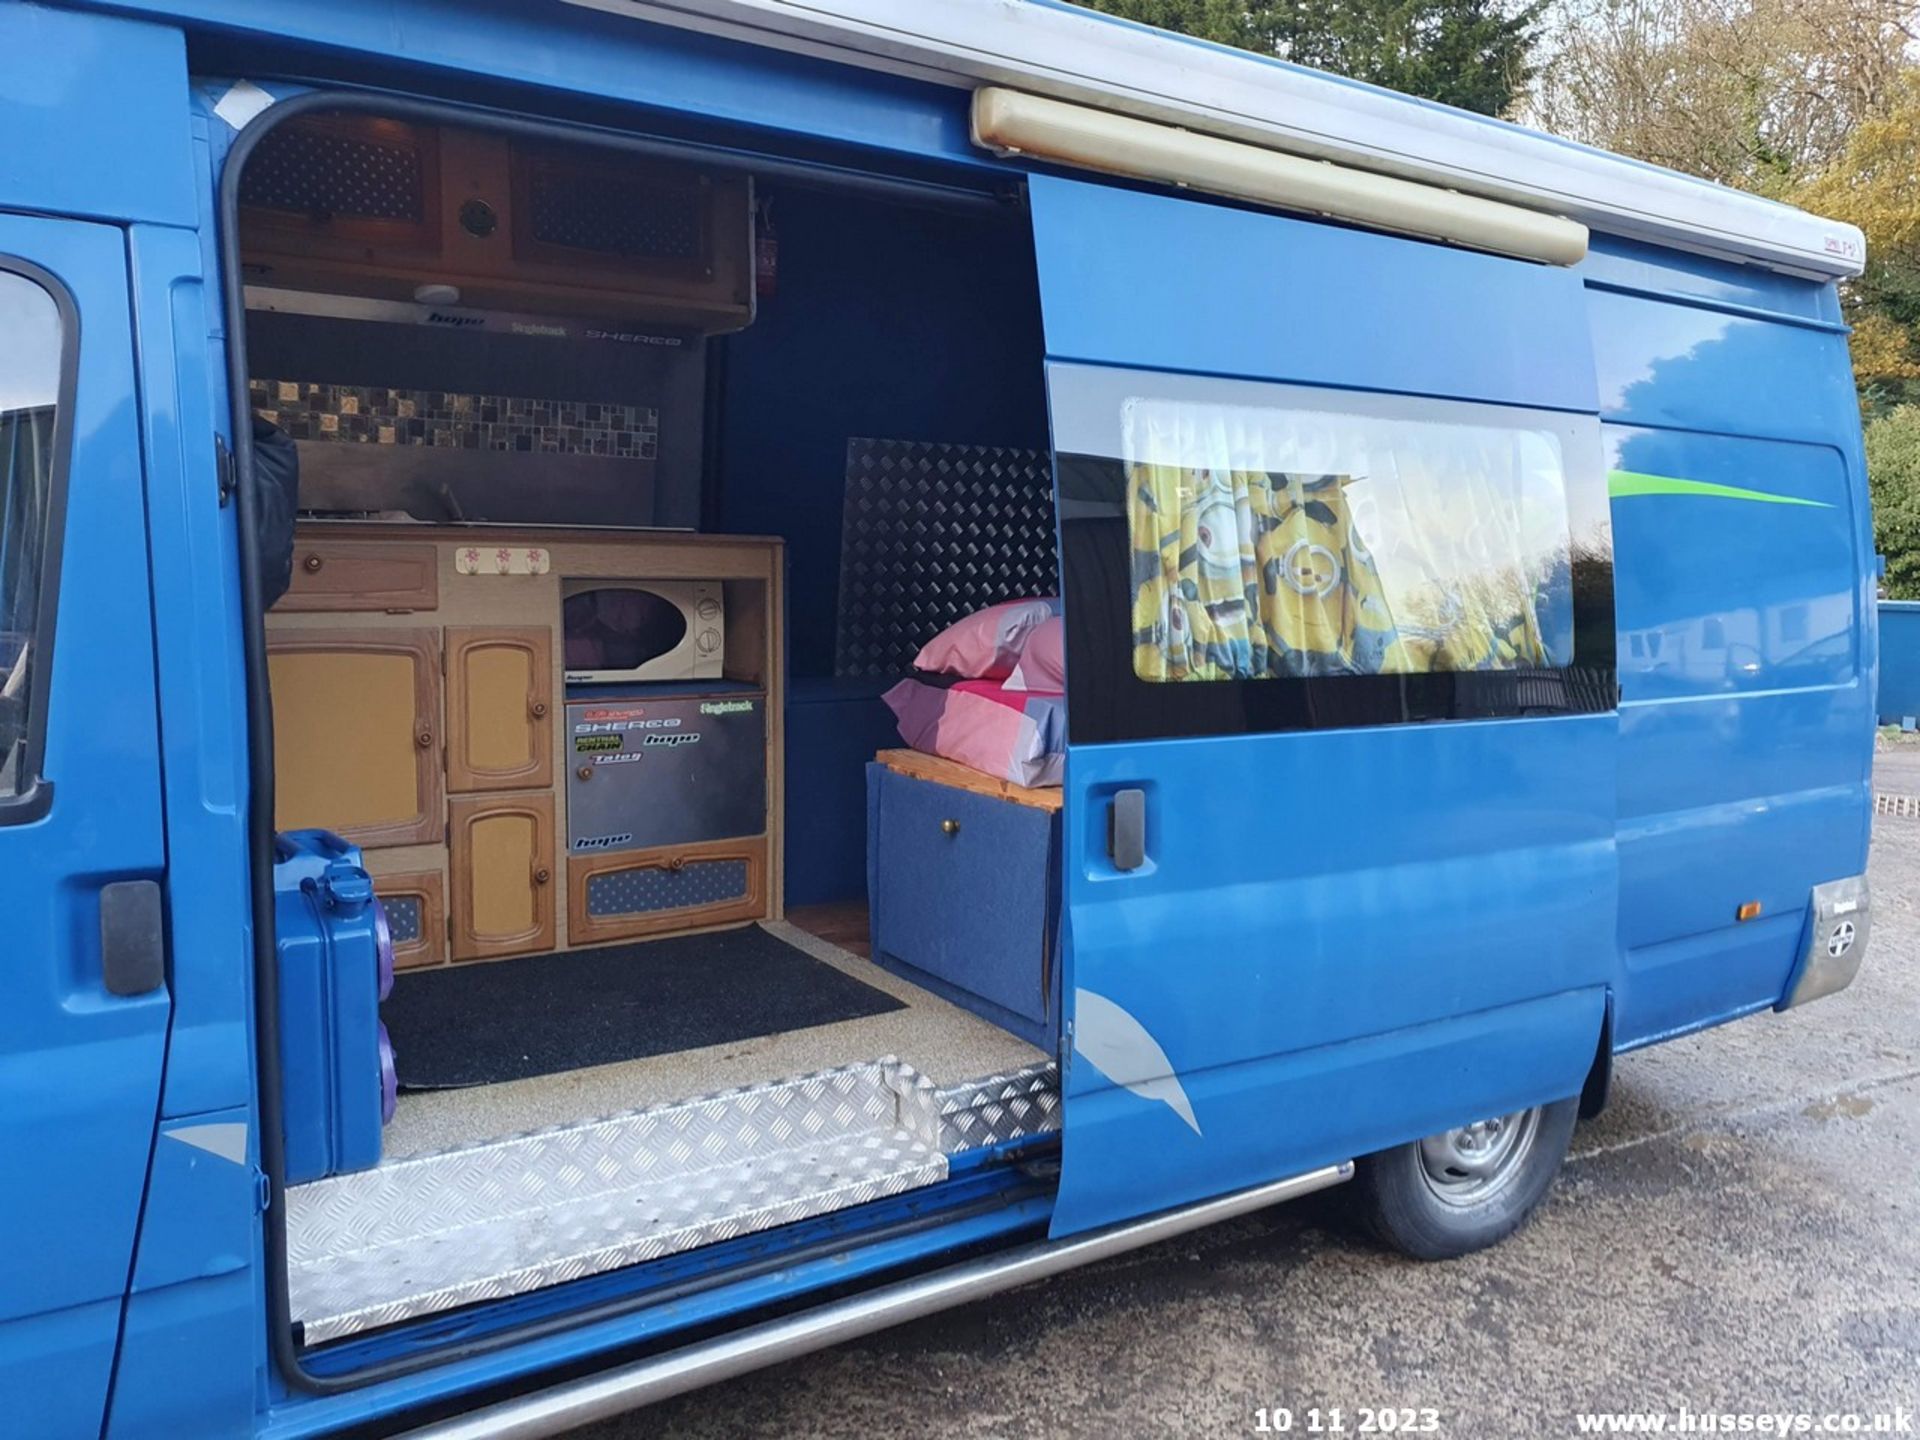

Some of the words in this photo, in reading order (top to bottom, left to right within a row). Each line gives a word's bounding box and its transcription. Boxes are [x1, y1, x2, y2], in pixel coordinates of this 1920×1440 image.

[585, 328, 682, 347] SHERCO
[575, 718, 682, 733] SHERCO
[577, 742, 622, 753] CHAIN
